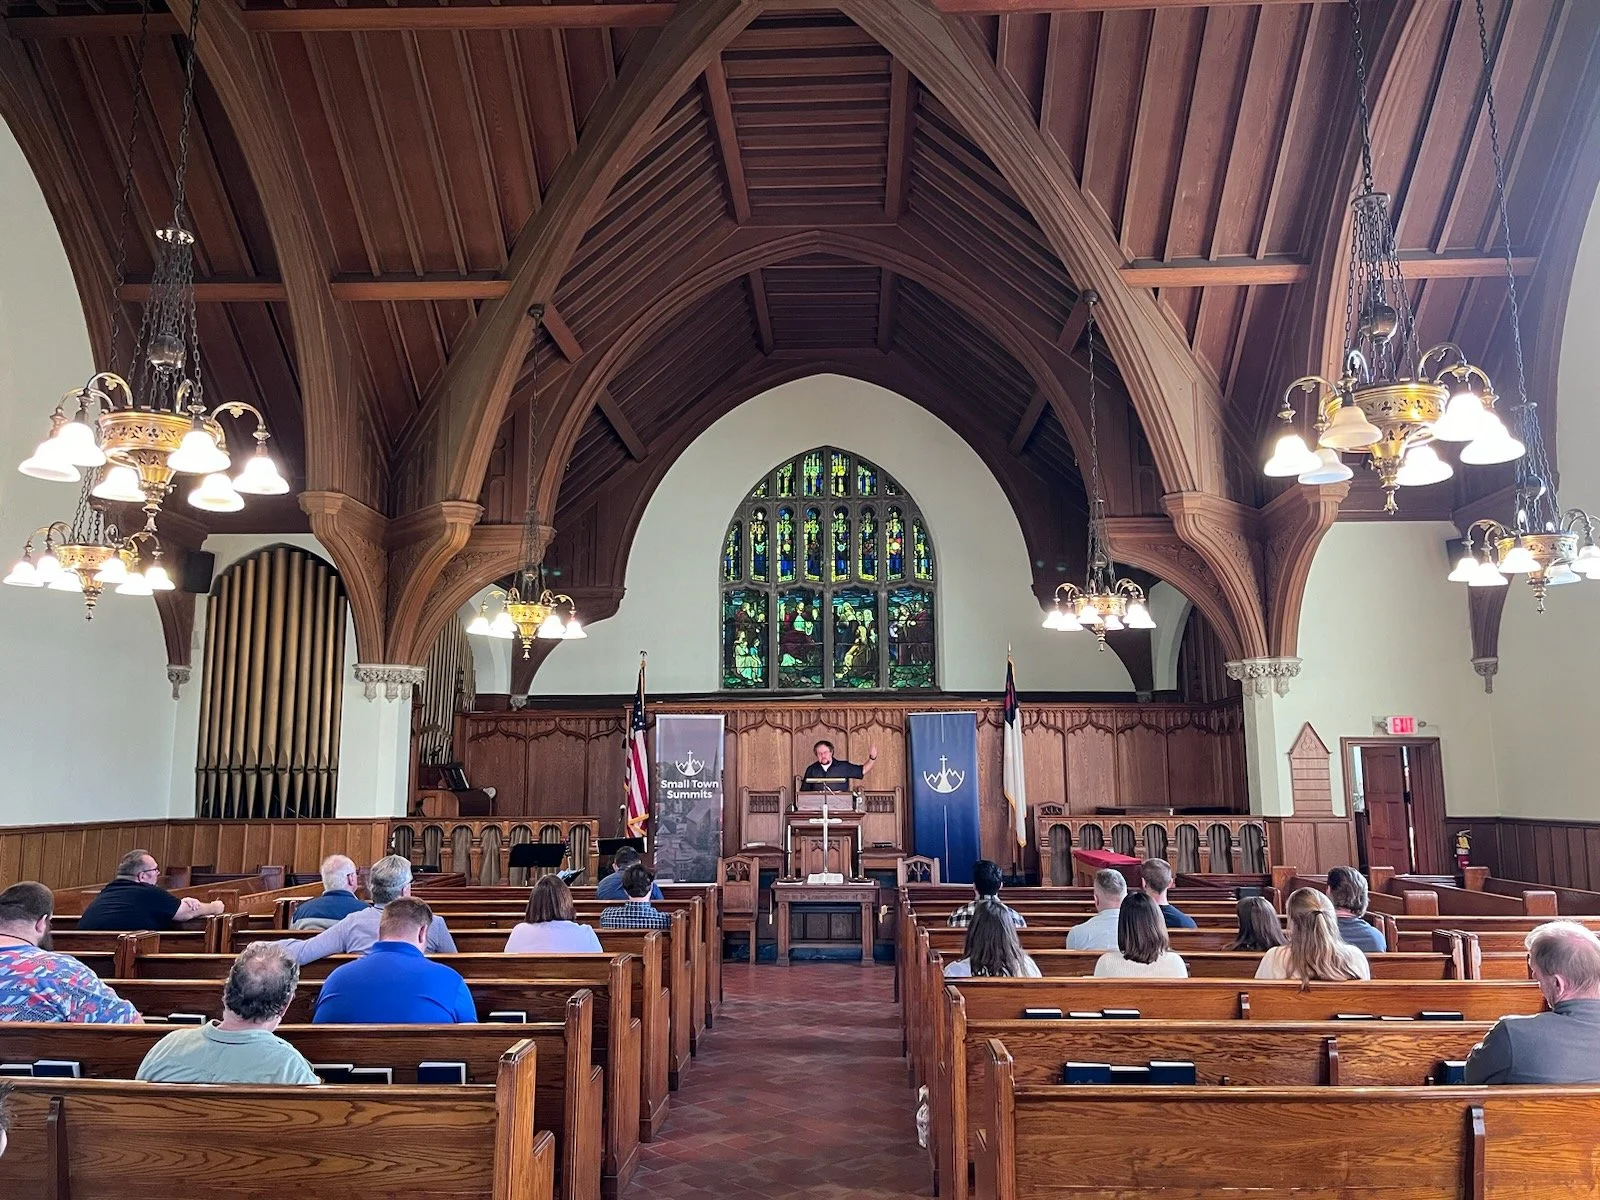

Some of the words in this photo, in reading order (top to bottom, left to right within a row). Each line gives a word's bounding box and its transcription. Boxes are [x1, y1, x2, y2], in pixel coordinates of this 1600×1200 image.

[1392, 717, 1414, 733] EXIT
[660, 779, 690, 789] Small
[691, 779, 719, 789] Town
[666, 789, 713, 799] Summits
